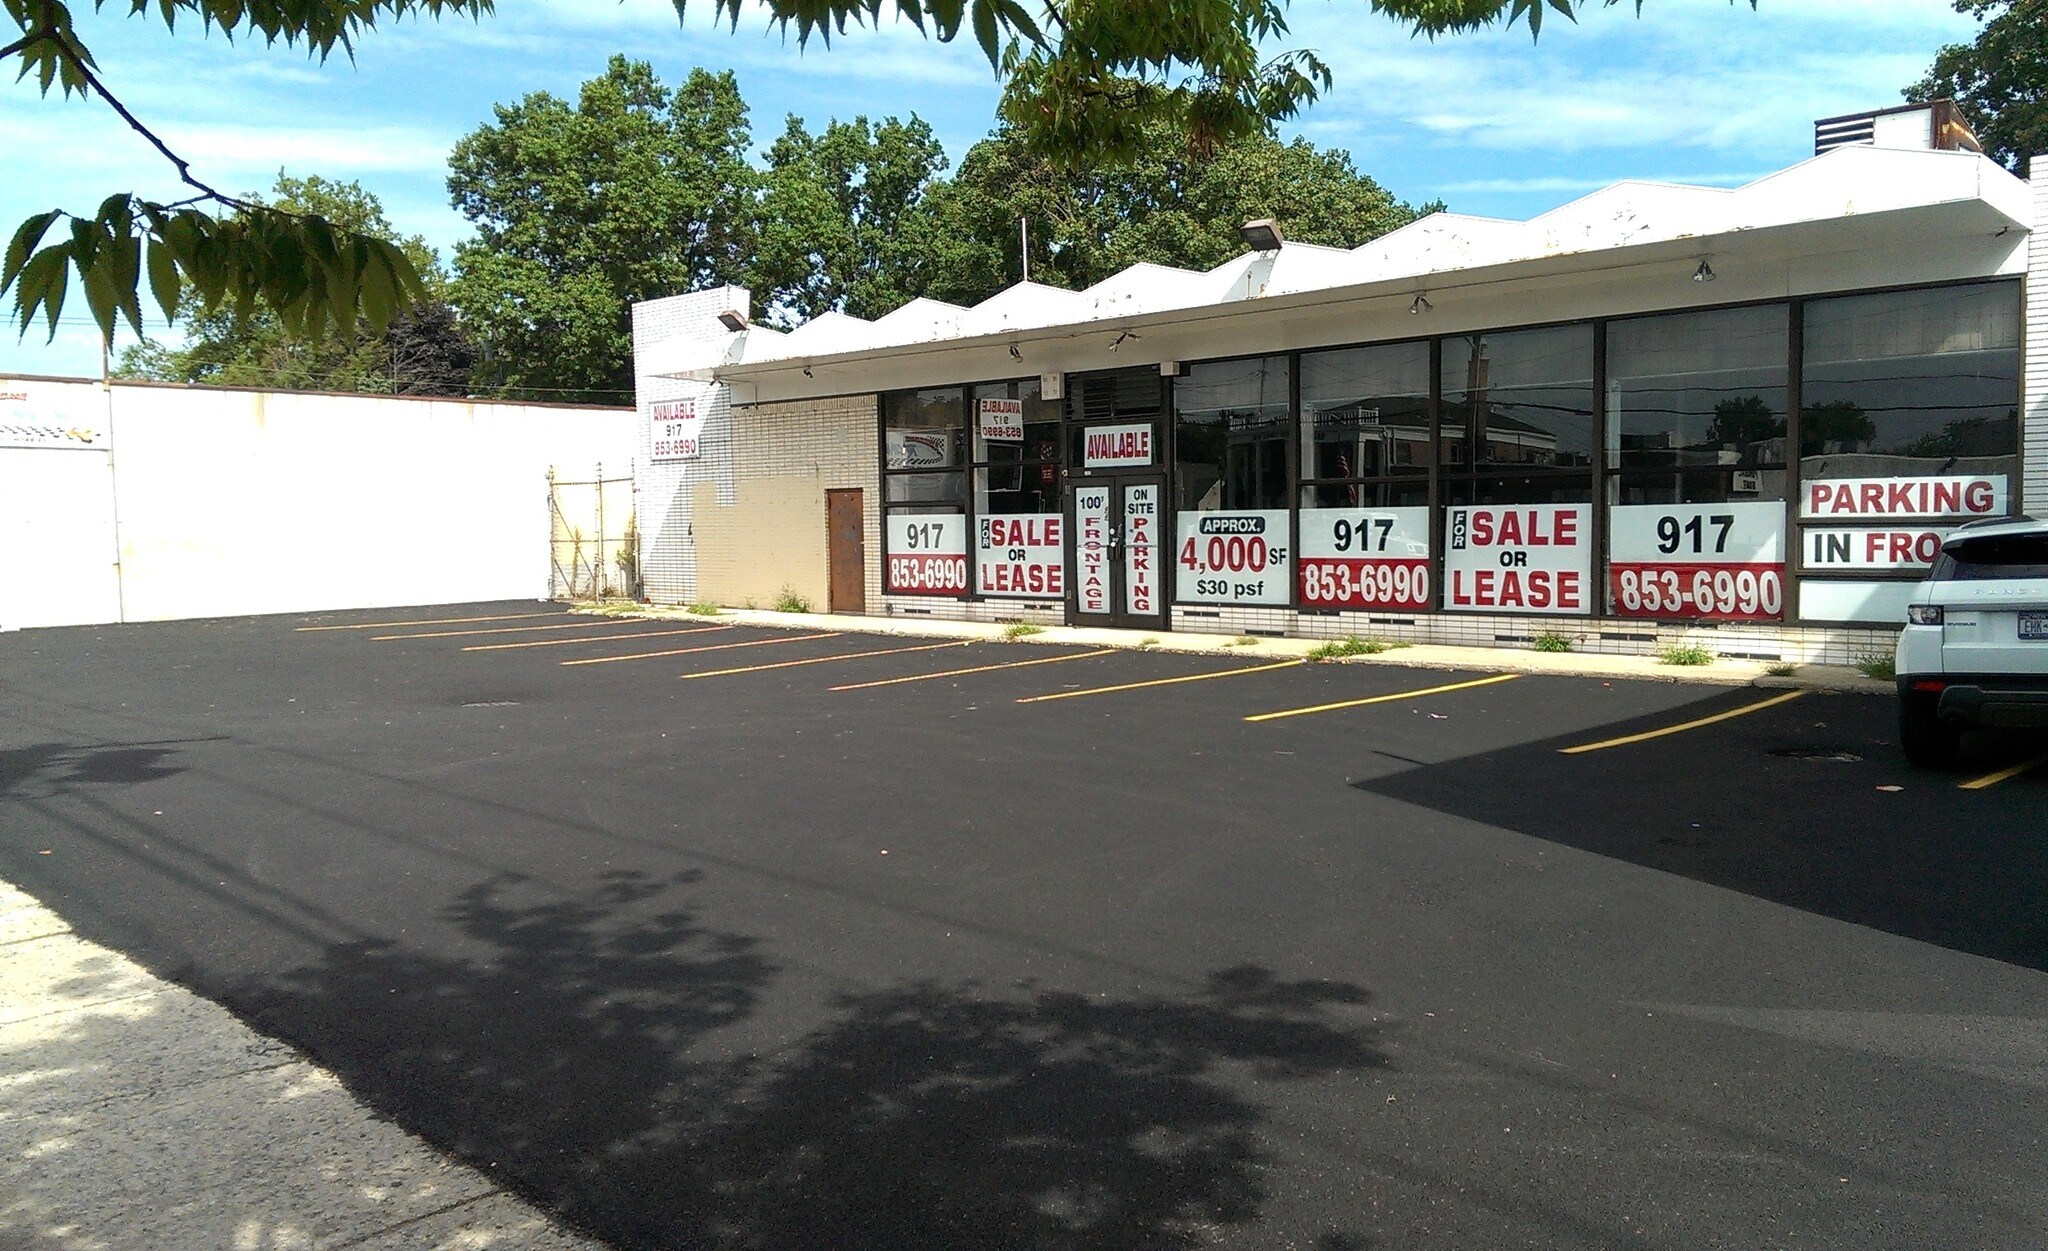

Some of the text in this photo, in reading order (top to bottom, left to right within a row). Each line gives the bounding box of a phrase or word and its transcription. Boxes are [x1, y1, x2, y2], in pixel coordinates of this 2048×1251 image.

[654, 402, 695, 421] AVAILABLE
[666, 424, 682, 436] 917
[655, 439, 696, 455] 853-6990
[1087, 431, 1149, 459] AVAILABLE
[1128, 503, 1154, 514] SITE
[1133, 489, 1148, 500] ON
[1811, 481, 1994, 513] PARKING
[907, 523, 943, 548] 917
[982, 520, 990, 548] FOR
[991, 519, 1060, 546] SALE
[1204, 519, 1261, 532] APPROX.
[1333, 519, 1394, 552] 917
[1453, 514, 1464, 548] FOR
[1472, 510, 1577, 546] SALE
[1657, 515, 1734, 554] 917
[1008, 549, 1026, 561] OR
[1180, 536, 1287, 574] 4,000 SF
[1500, 551, 1527, 567] OR
[1815, 533, 1944, 563] IN FRO
[891, 558, 966, 589] 853-6990
[1084, 517, 1102, 609] FRONTAGE
[1133, 518, 1149, 611] PARKING
[982, 564, 1061, 593] LEASE
[1197, 580, 1264, 599] $30 psf
[1305, 564, 1429, 603] 853-6990
[1453, 571, 1579, 608] LEASE
[1621, 570, 1782, 615] 853-6990
